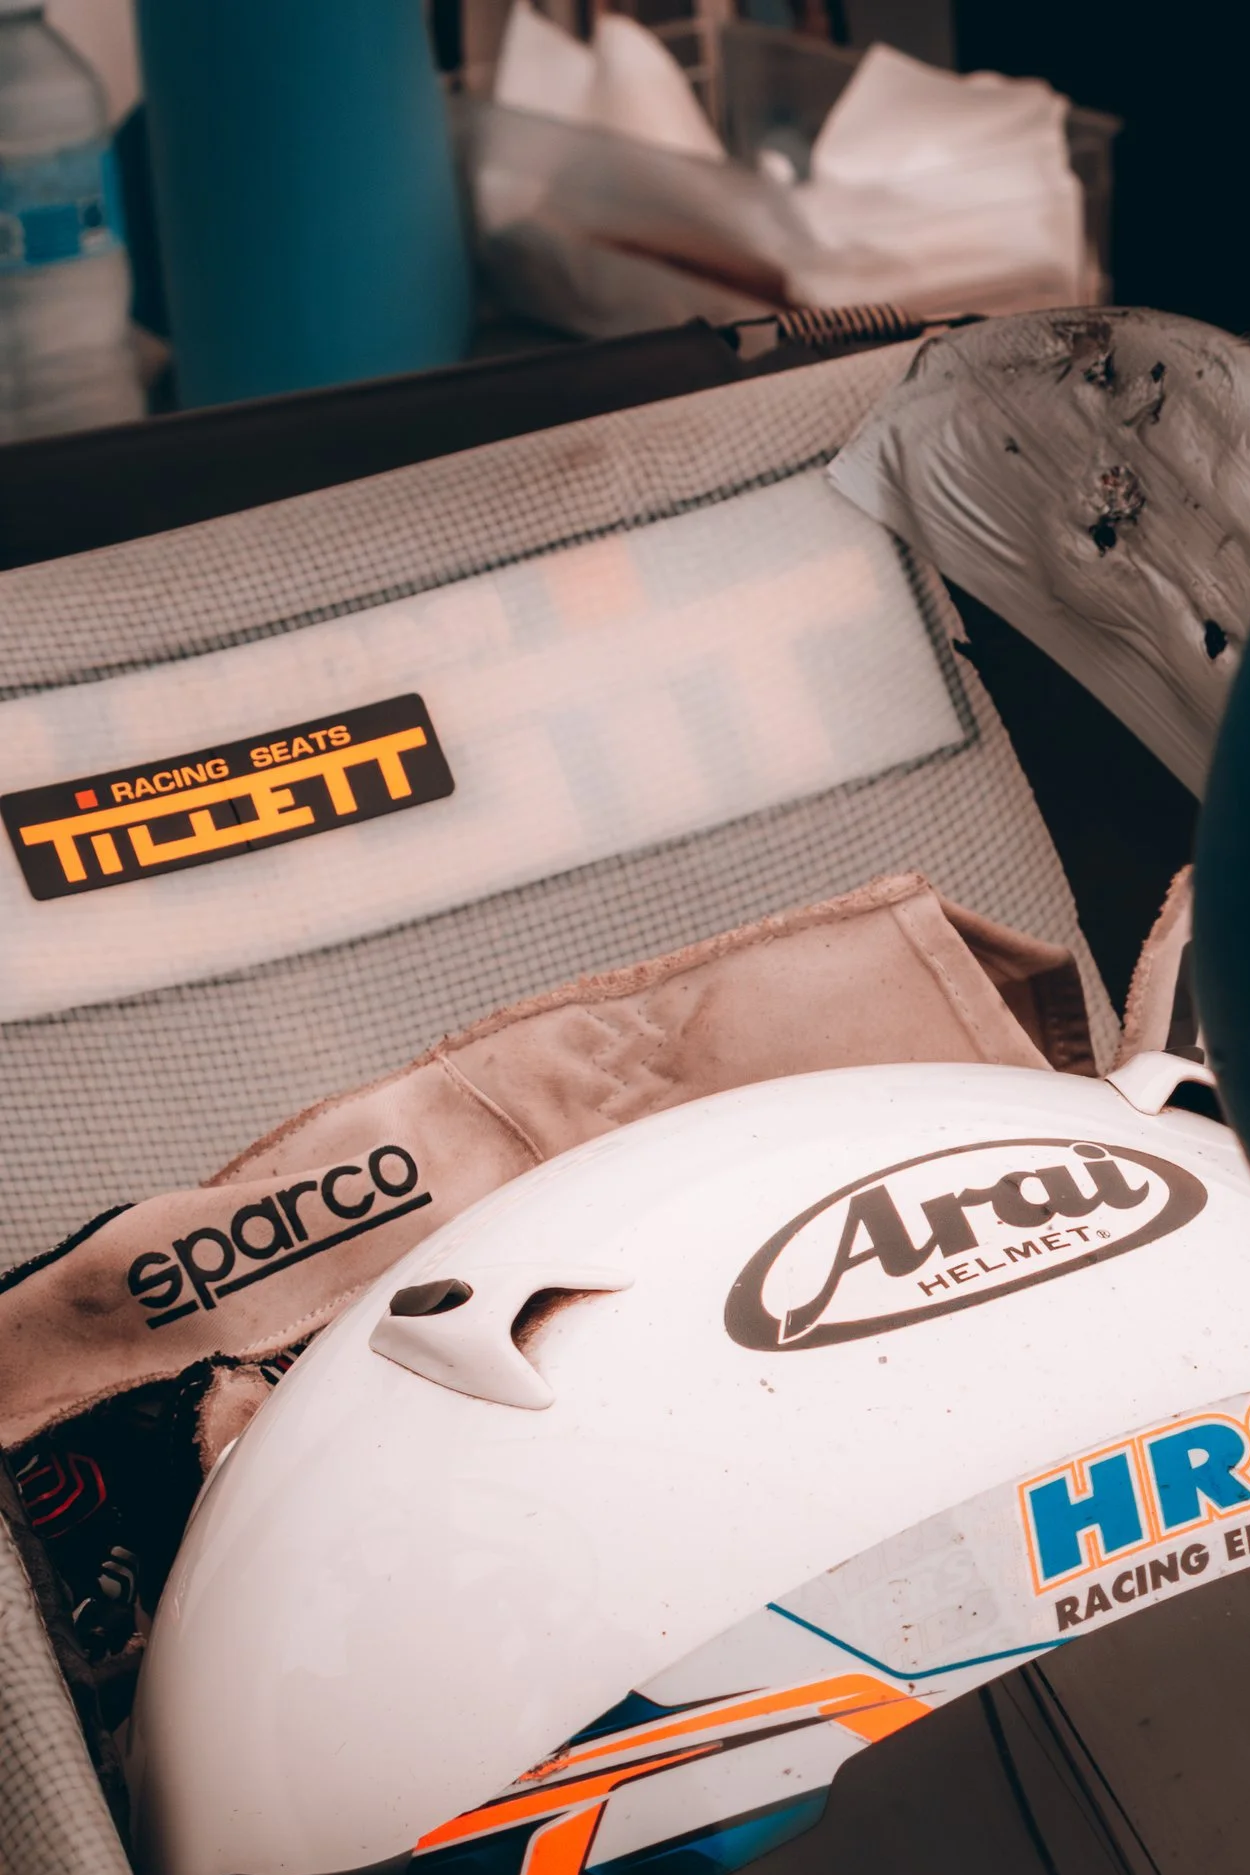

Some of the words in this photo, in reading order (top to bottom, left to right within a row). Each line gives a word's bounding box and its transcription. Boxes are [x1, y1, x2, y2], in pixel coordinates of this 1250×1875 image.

[19, 726, 428, 884] TILLETT
[111, 758, 229, 803] RACING
[250, 724, 352, 768] SEATS
[128, 1144, 419, 1311] sparco
[782, 1142, 1151, 1343] Arai
[1054, 1543, 1211, 1633] RACING
